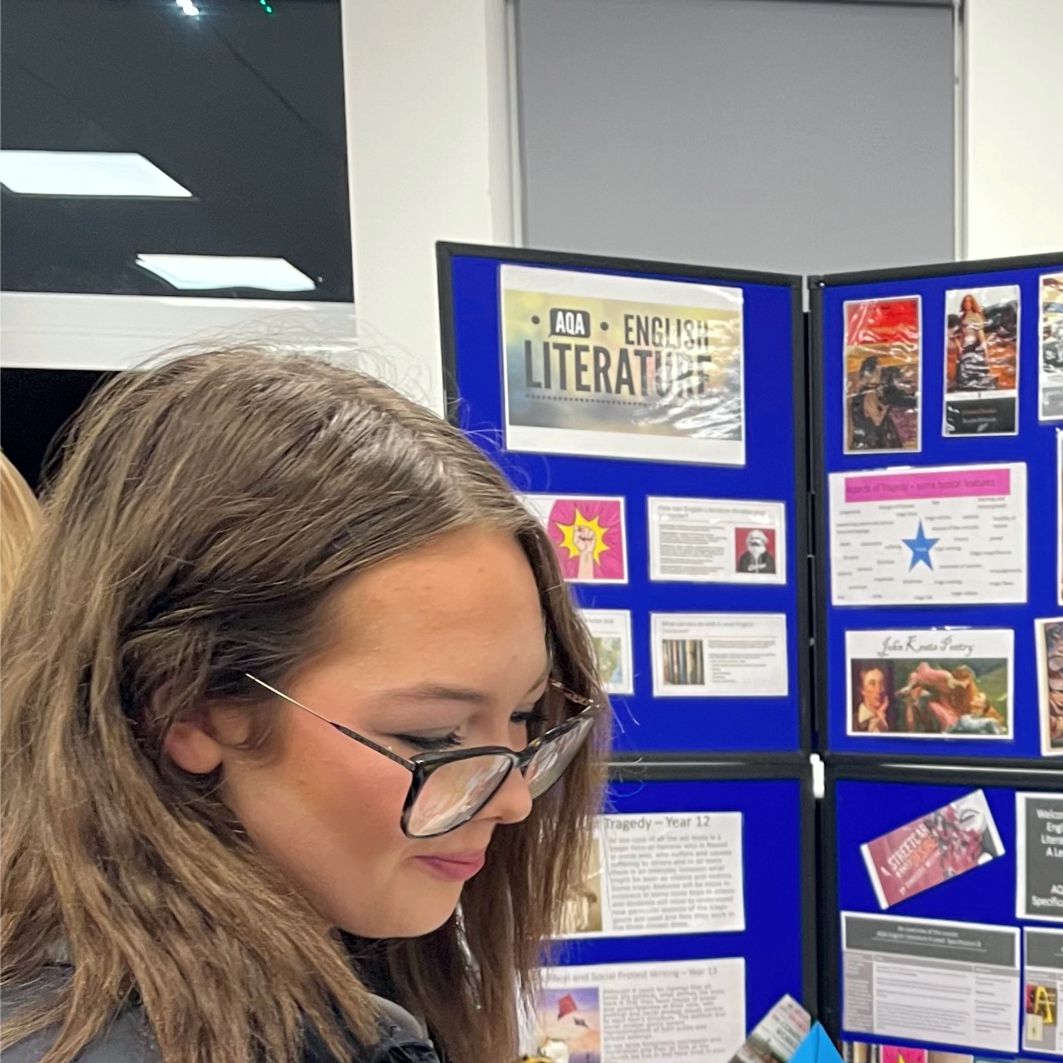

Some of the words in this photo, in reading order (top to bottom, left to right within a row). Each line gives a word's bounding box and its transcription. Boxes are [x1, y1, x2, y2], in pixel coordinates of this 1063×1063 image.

[554, 310, 586, 336] AQA
[623, 313, 709, 352] ENGLISH
[603, 816, 653, 832] Tragedy
[664, 816, 692, 829] Year
[696, 815, 711, 828] 12
[1045, 846, 1054, 857] A
